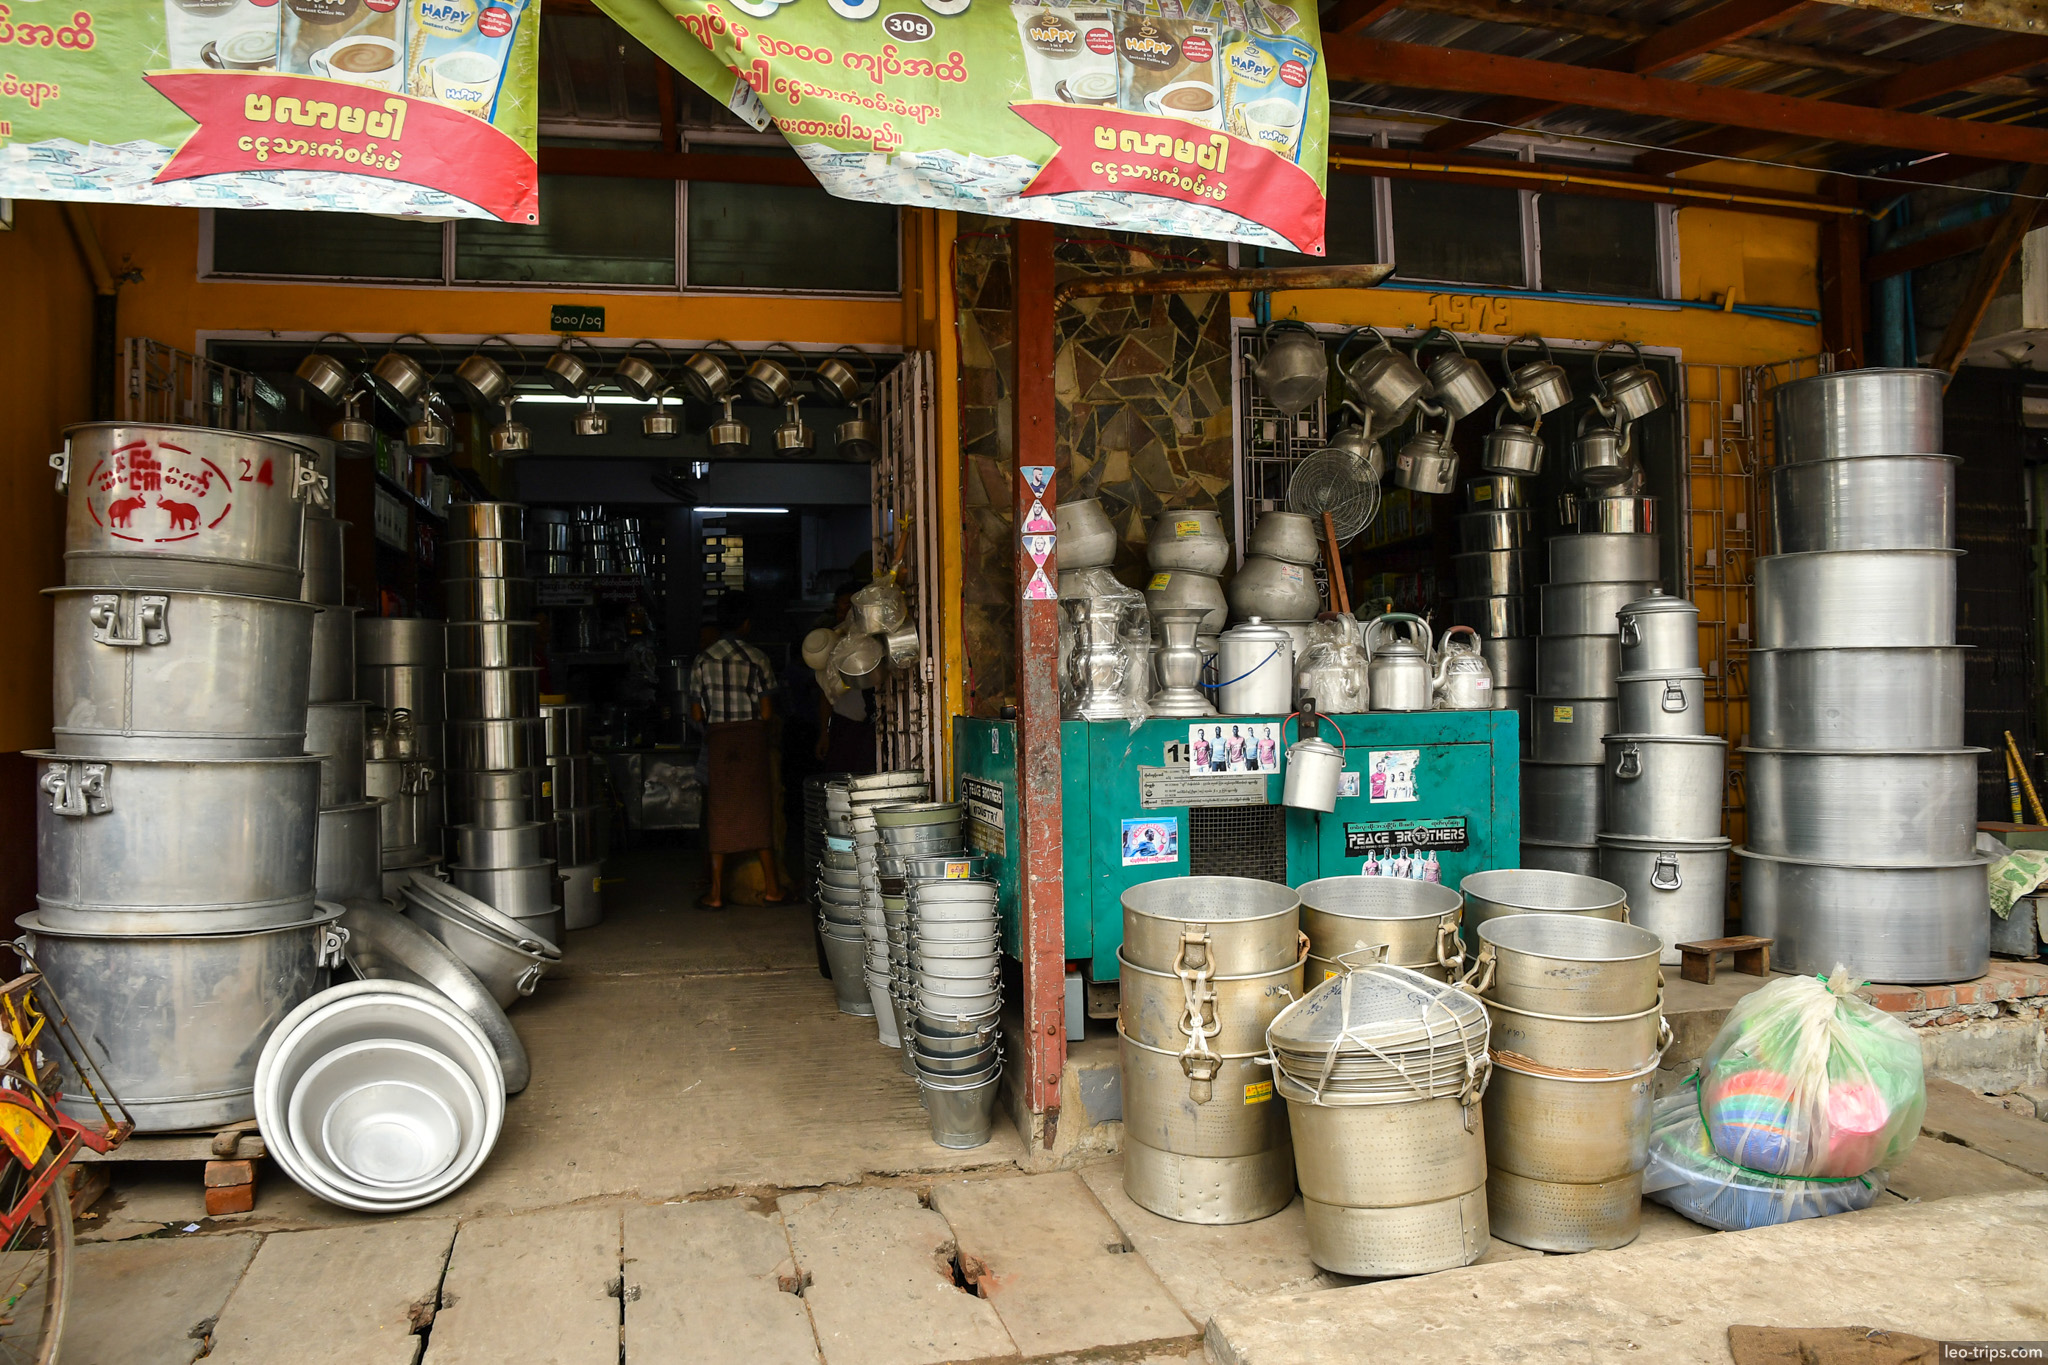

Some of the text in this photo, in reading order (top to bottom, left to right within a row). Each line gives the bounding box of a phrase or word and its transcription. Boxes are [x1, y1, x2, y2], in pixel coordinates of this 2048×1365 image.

[296, 6, 316, 14] Instant
[421, 2, 472, 24] HAPPY
[422, 20, 463, 33] Instant Cereal
[889, 17, 929, 37] 30g
[1030, 27, 1076, 44] HAPPY
[1125, 37, 1172, 55] HAPPY
[1231, 55, 1273, 76] HAPPY
[1232, 70, 1250, 79] Instant
[445, 88, 482, 102] HAPPY
[1259, 130, 1289, 145] HAPPY
[1348, 832, 1390, 848] PEACE
[1394, 826, 1465, 845] BROTHERS
